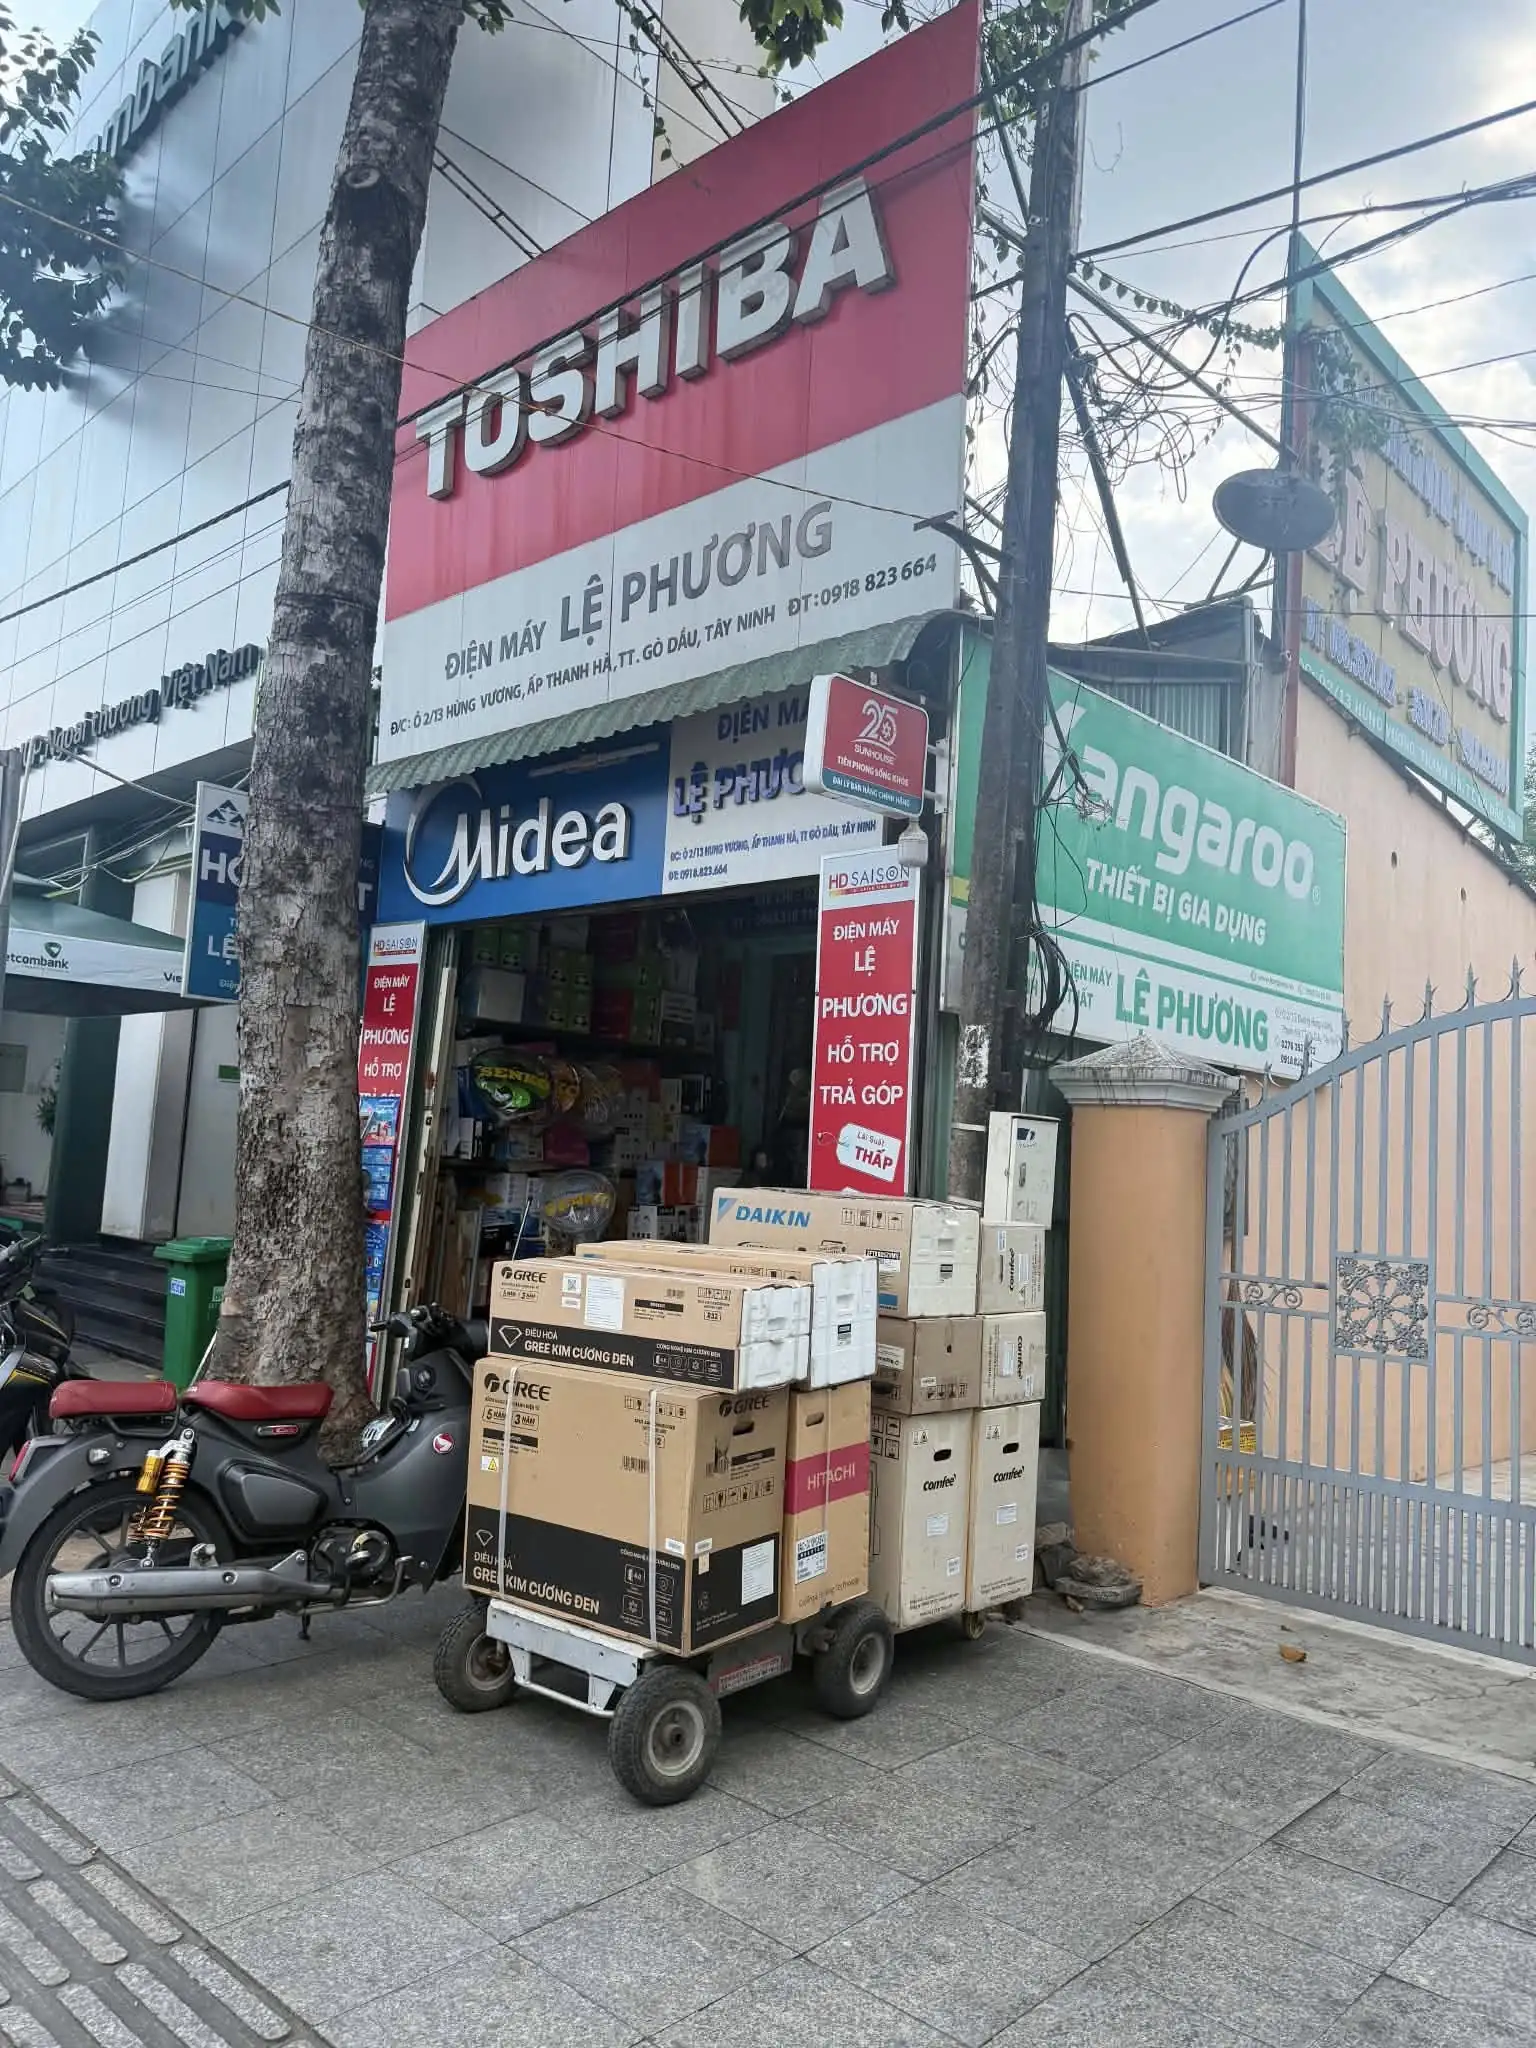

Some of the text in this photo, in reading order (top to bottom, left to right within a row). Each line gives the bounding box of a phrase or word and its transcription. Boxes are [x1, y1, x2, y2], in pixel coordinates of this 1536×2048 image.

[415, 176, 895, 500] TOSHIBA
[445, 500, 833, 680] ĐIỆN MÁY LỆ PHƯƠNG
[423, 707, 444, 726] 2/13
[480, 683, 526, 707] VƯƠNG,
[527, 673, 543, 695] ẤP
[546, 662, 589, 689] THANH
[642, 637, 664, 660] GÒ
[667, 626, 702, 655] DẦU,
[704, 618, 732, 643] TÂY
[737, 604, 776, 634] NINH
[864, 566, 899, 592] 823
[899, 552, 938, 581] 664
[161, 661, 200, 710] Việt
[202, 643, 259, 689] Nam
[862, 698, 898, 746] 25
[854, 743, 897, 765] SUNHOUSE
[852, 761, 875, 776] PHONG
[874, 766, 892, 781] SỐNG
[673, 761, 709, 825] LỆ
[430, 799, 630, 887] Midea
[689, 847, 703, 859] 2/13
[762, 833, 785, 847] THANH
[808, 827, 821, 840] GÒ
[841, 822, 856, 837] TÂY
[857, 819, 877, 833] NINH
[828, 872, 849, 890] HD
[851, 864, 910, 887] SAISON
[1085, 858, 1267, 947] THIẾT BỊ GIA DỤNG
[374, 937, 418, 950] HD SAISON
[833, 916, 900, 943] ĐIỆN MÁY
[207, 932, 239, 966] LỆ
[853, 944, 877, 977] LỆ
[373, 975, 410, 991] ĐIỆN MÁY
[1066, 959, 1087, 982] IỆN
[1090, 964, 1112, 987] MÁY
[383, 993, 396, 1016] LỆ
[821, 991, 909, 1019] PHƯƠNG
[1066, 986, 1094, 1010] TẤT
[1157, 991, 1269, 1052] PHƯƠNG
[363, 1027, 410, 1045] PHƯƠNG
[827, 1034, 900, 1067] HỖ TRỢ
[364, 1056, 403, 1081] HỖ TRỢ
[820, 1077, 904, 1107] TRẢ GÓP
[854, 1144, 894, 1171] THẤP
[736, 1205, 811, 1228] DAIKIN
[513, 1269, 548, 1284] GREE
[524, 1340, 634, 1368] GREE KIM CƯƠNG ĐEN
[502, 1379, 552, 1402] GREE
[486, 1408, 493, 1420] 5
[514, 1413, 521, 1425] 3
[733, 1394, 770, 1416] GREE
[807, 1462, 857, 1491] HITACHI
[505, 1575, 527, 1593] KIM
[529, 1580, 573, 1606] CƯƠNG
[574, 1594, 600, 1616] ĐEN
